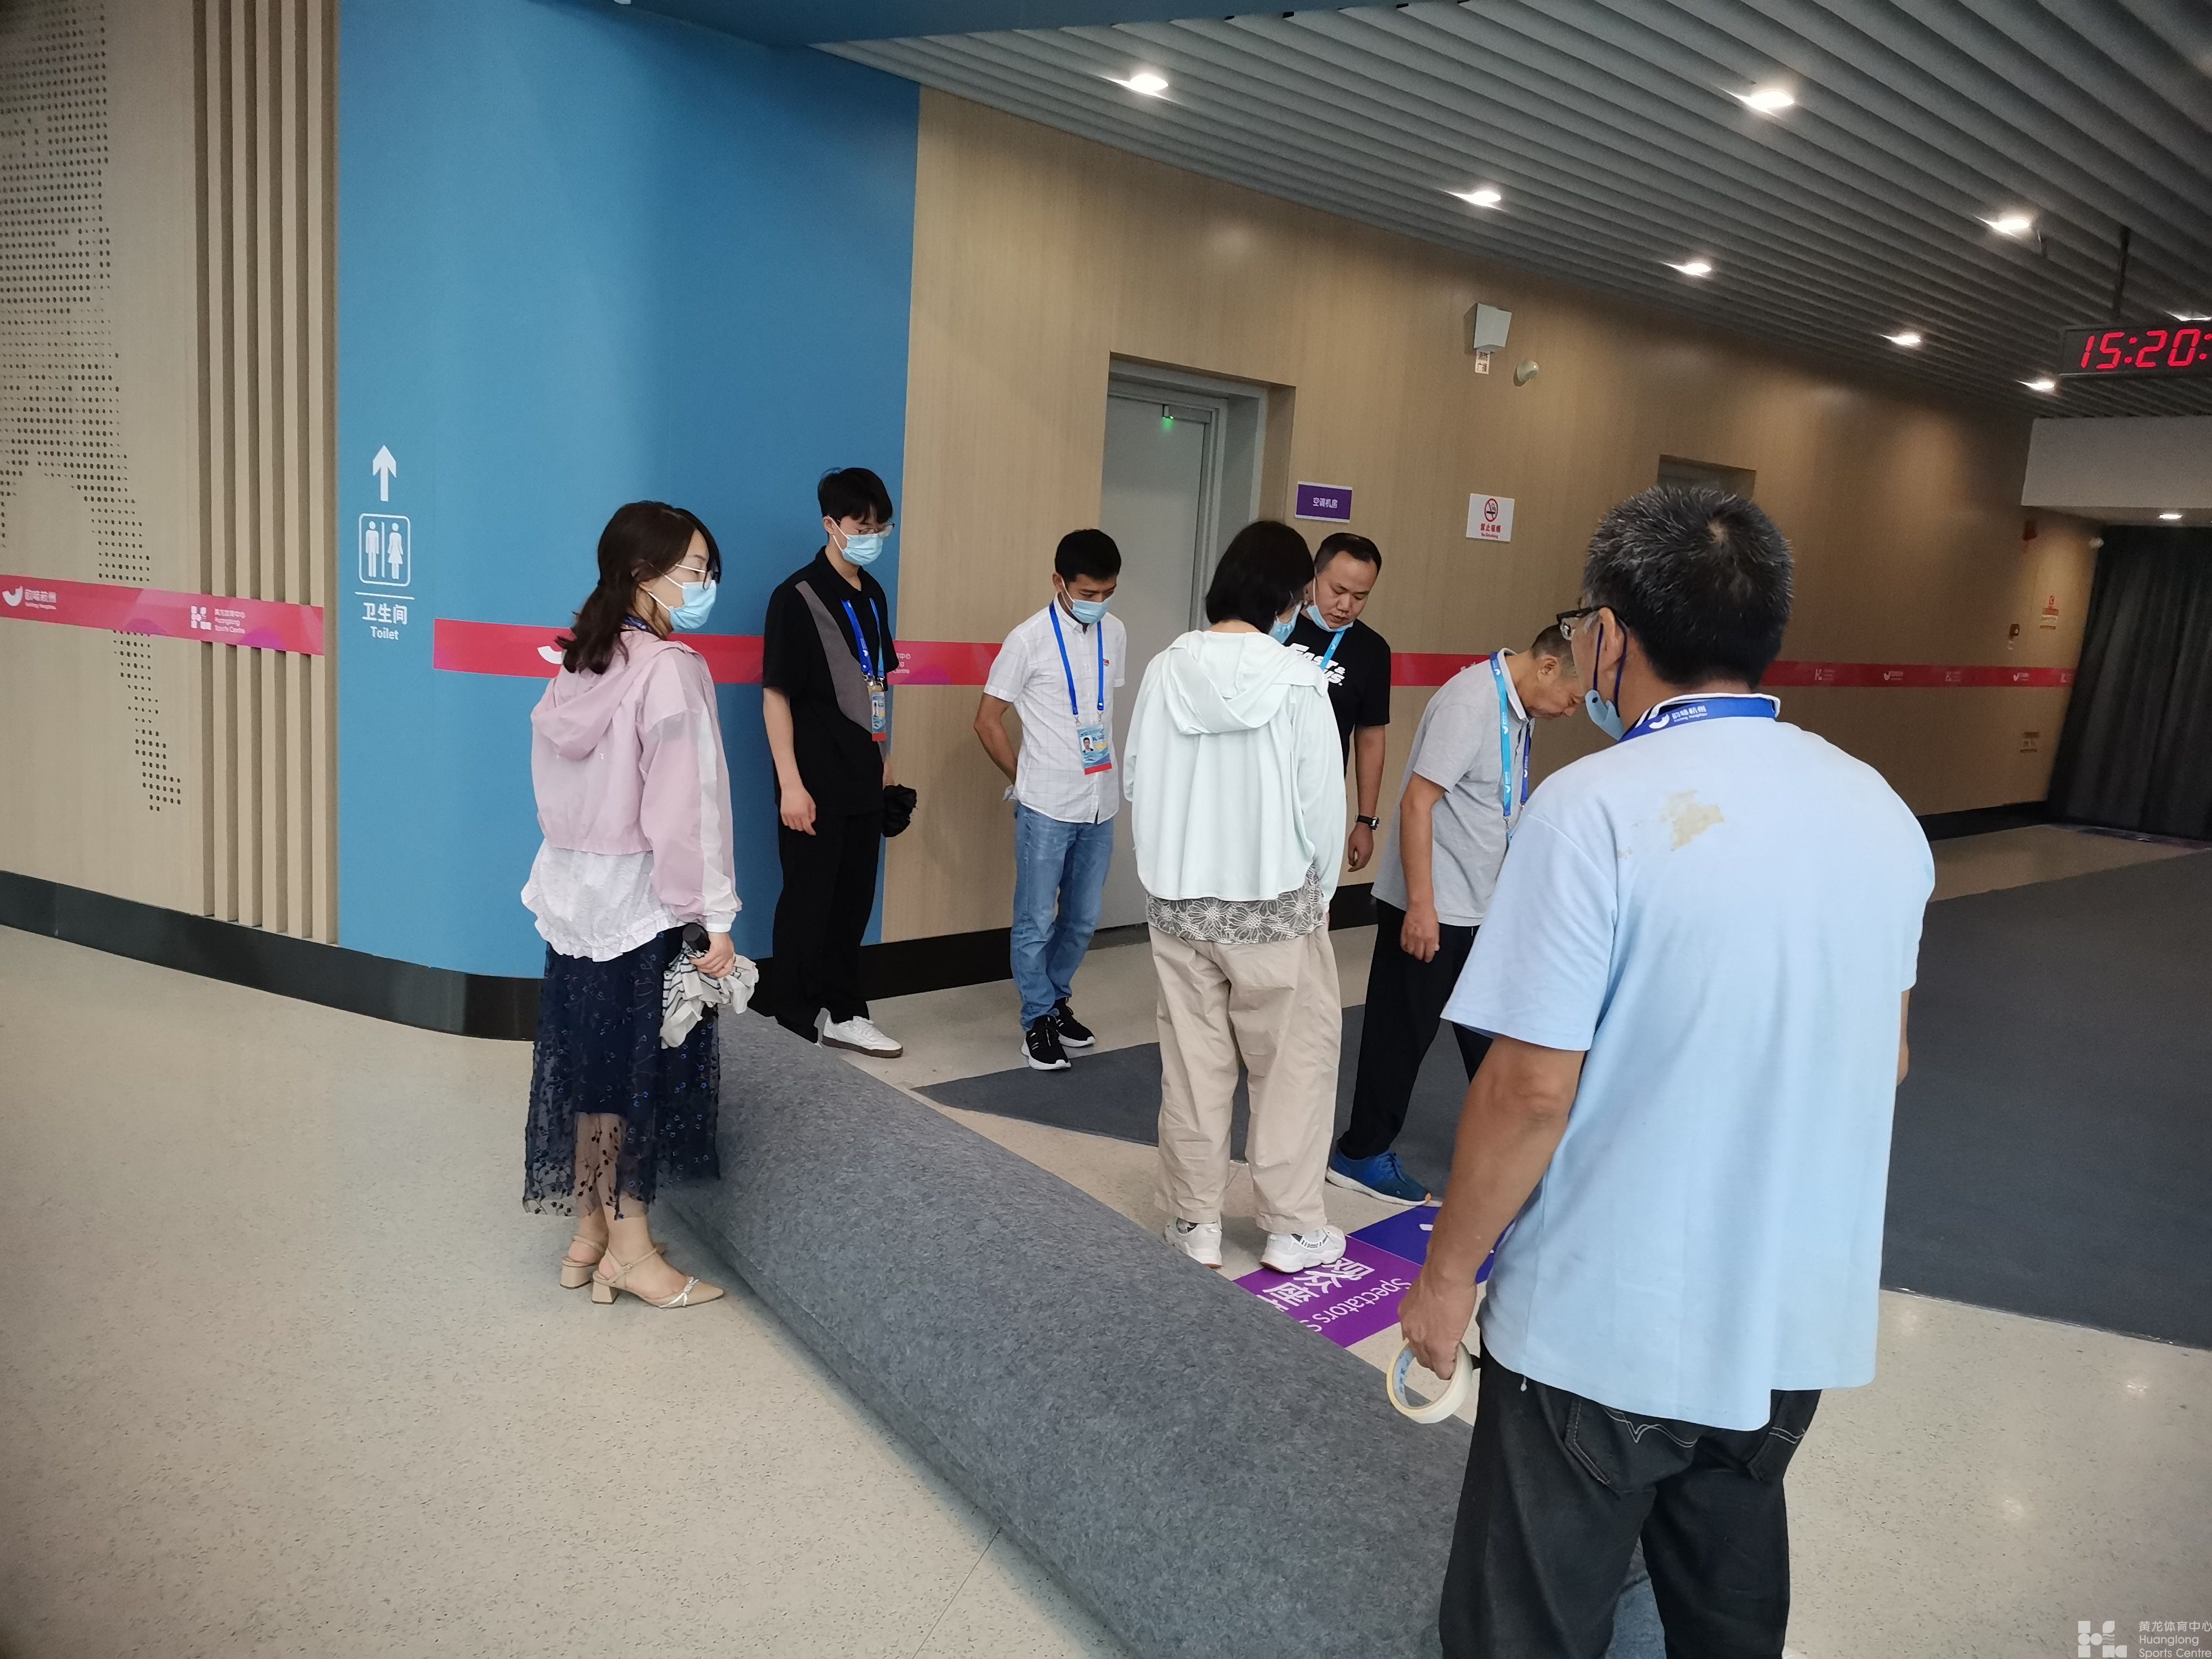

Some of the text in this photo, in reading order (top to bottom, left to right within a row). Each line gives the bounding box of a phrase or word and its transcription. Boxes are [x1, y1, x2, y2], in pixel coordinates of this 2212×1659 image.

[362, 602, 408, 625] 卫生间
[370, 626, 399, 640] Toilet
